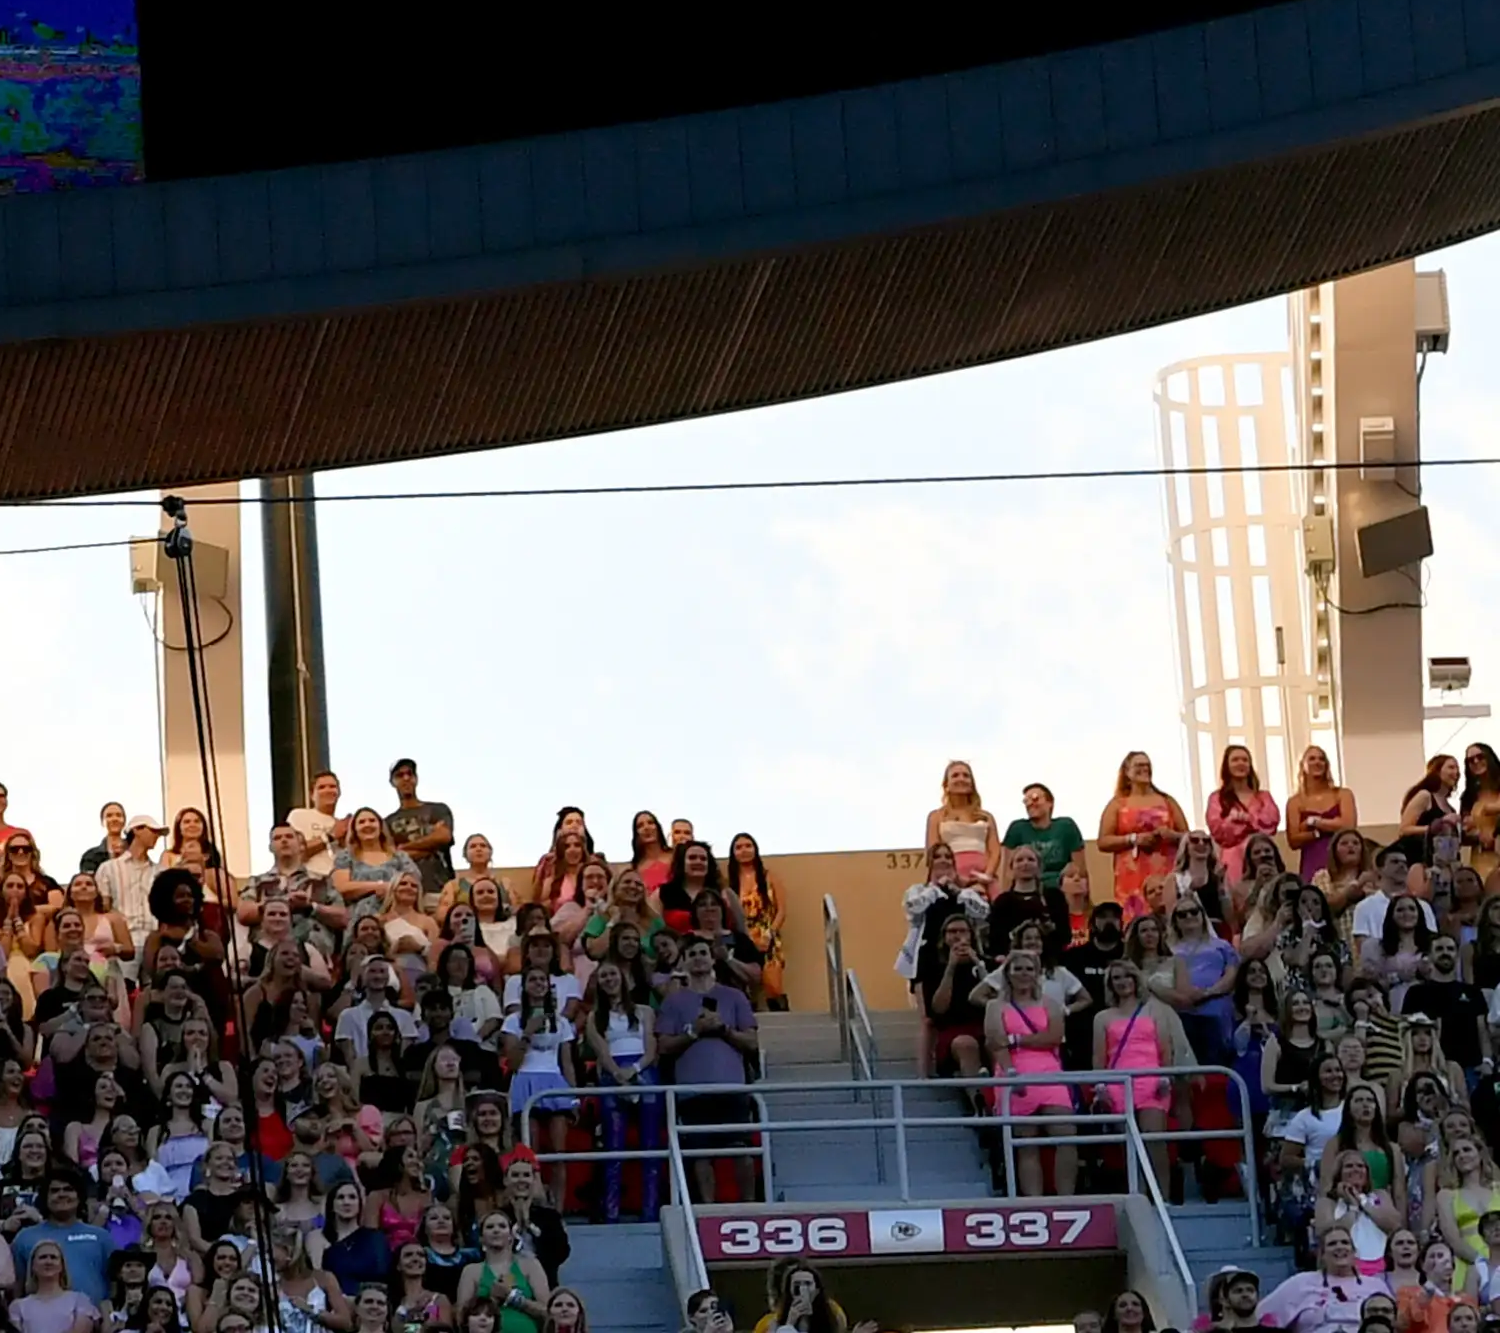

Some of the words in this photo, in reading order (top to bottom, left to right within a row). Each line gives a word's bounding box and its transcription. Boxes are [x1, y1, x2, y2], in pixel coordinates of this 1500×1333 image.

[886, 852, 924, 869] 337
[719, 1217, 848, 1255] 336
[965, 1209, 1091, 1247] 337
